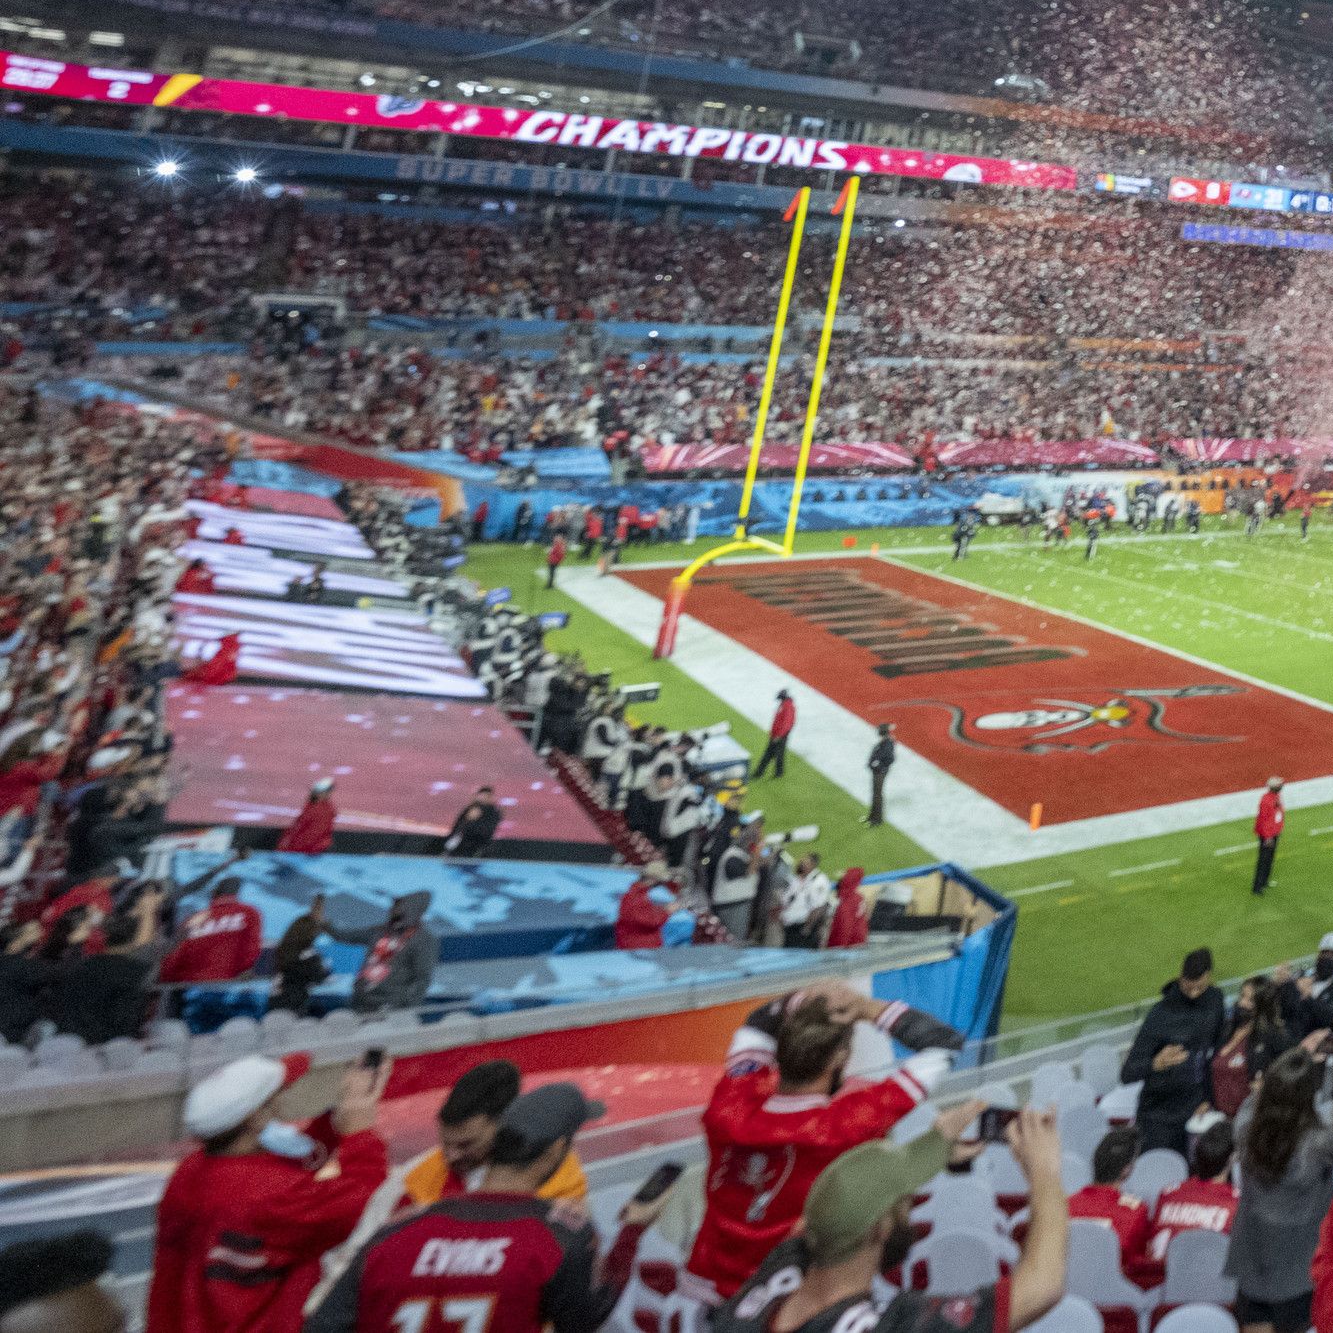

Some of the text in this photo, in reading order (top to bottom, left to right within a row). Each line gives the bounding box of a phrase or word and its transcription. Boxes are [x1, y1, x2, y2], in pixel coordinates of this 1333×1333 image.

[513, 109, 850, 172] CHAMPIONS
[395, 156, 512, 187] SUPER
[530, 166, 627, 196] BOWL
